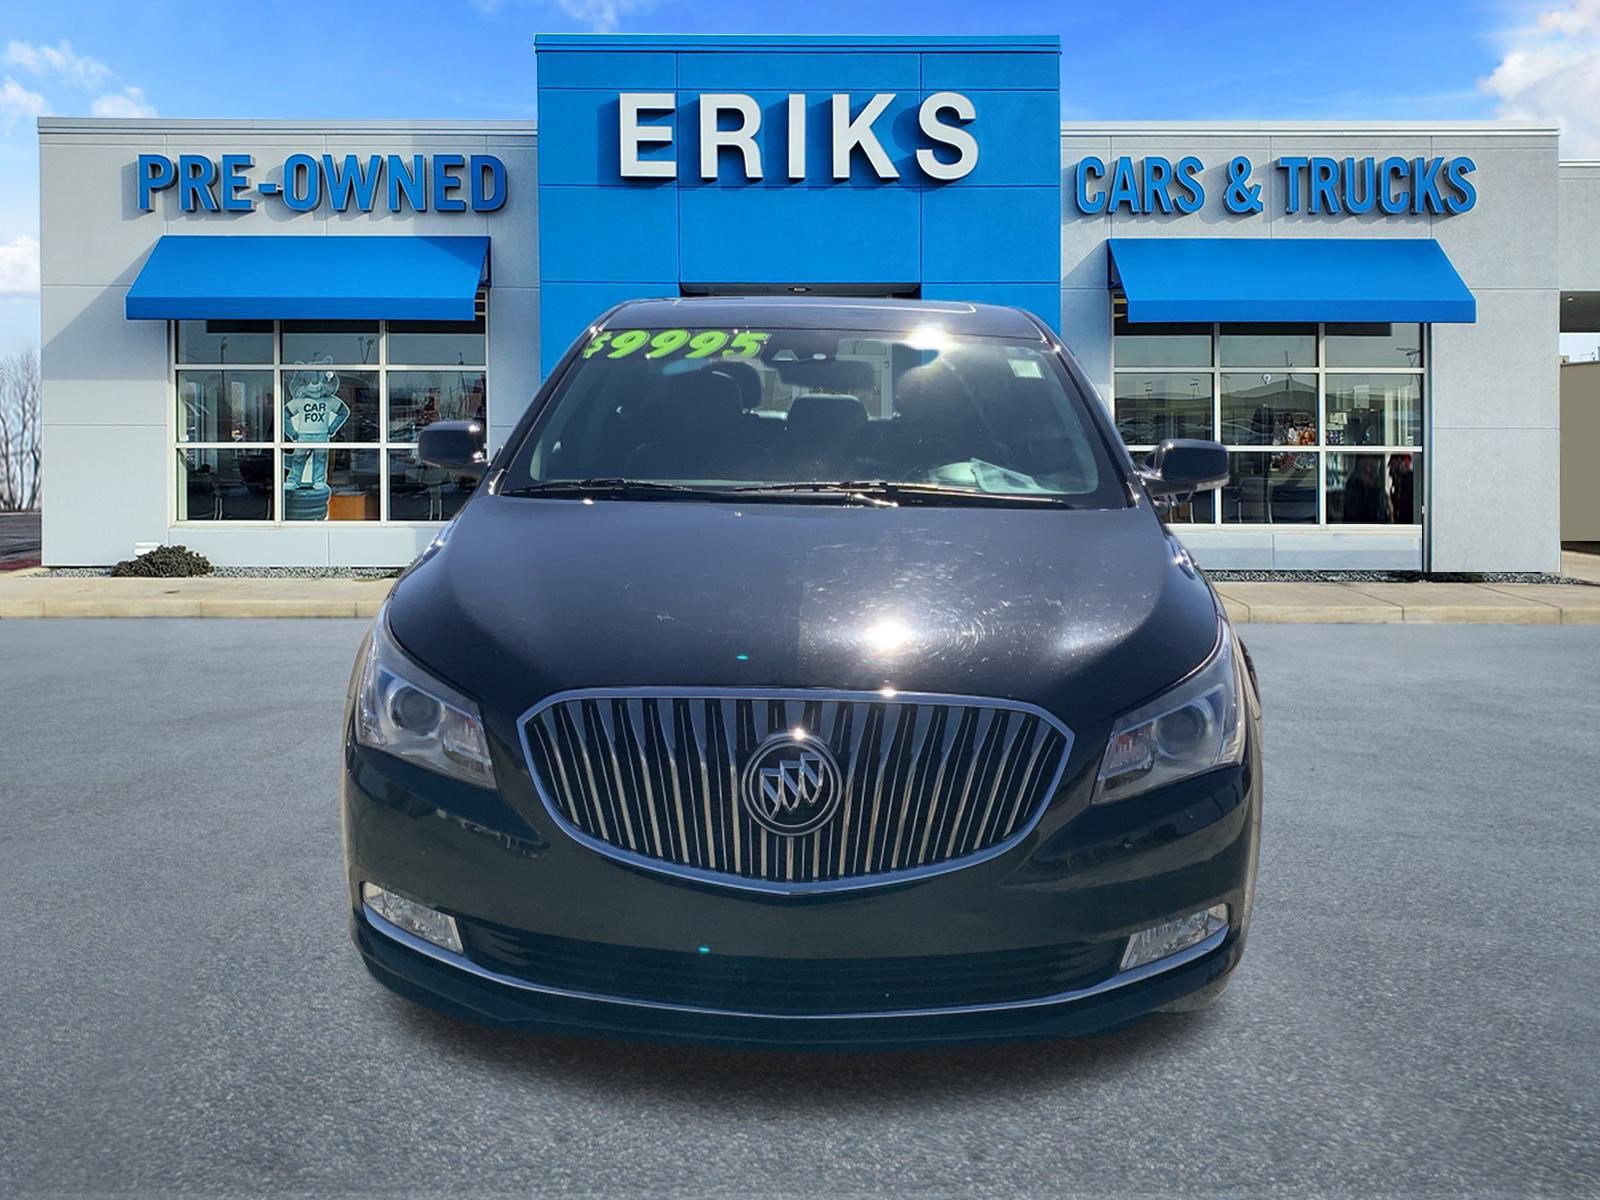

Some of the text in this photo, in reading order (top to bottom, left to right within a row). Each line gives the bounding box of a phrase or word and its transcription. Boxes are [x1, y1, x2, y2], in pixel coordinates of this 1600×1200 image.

[619, 91, 980, 182] ERIKS
[137, 153, 509, 214] PRE-OWNED
[1074, 155, 1478, 216] CARS & TRUCKS
[582, 328, 771, 360] $9995
[303, 402, 326, 412] CAR
[304, 412, 325, 423] FOX
